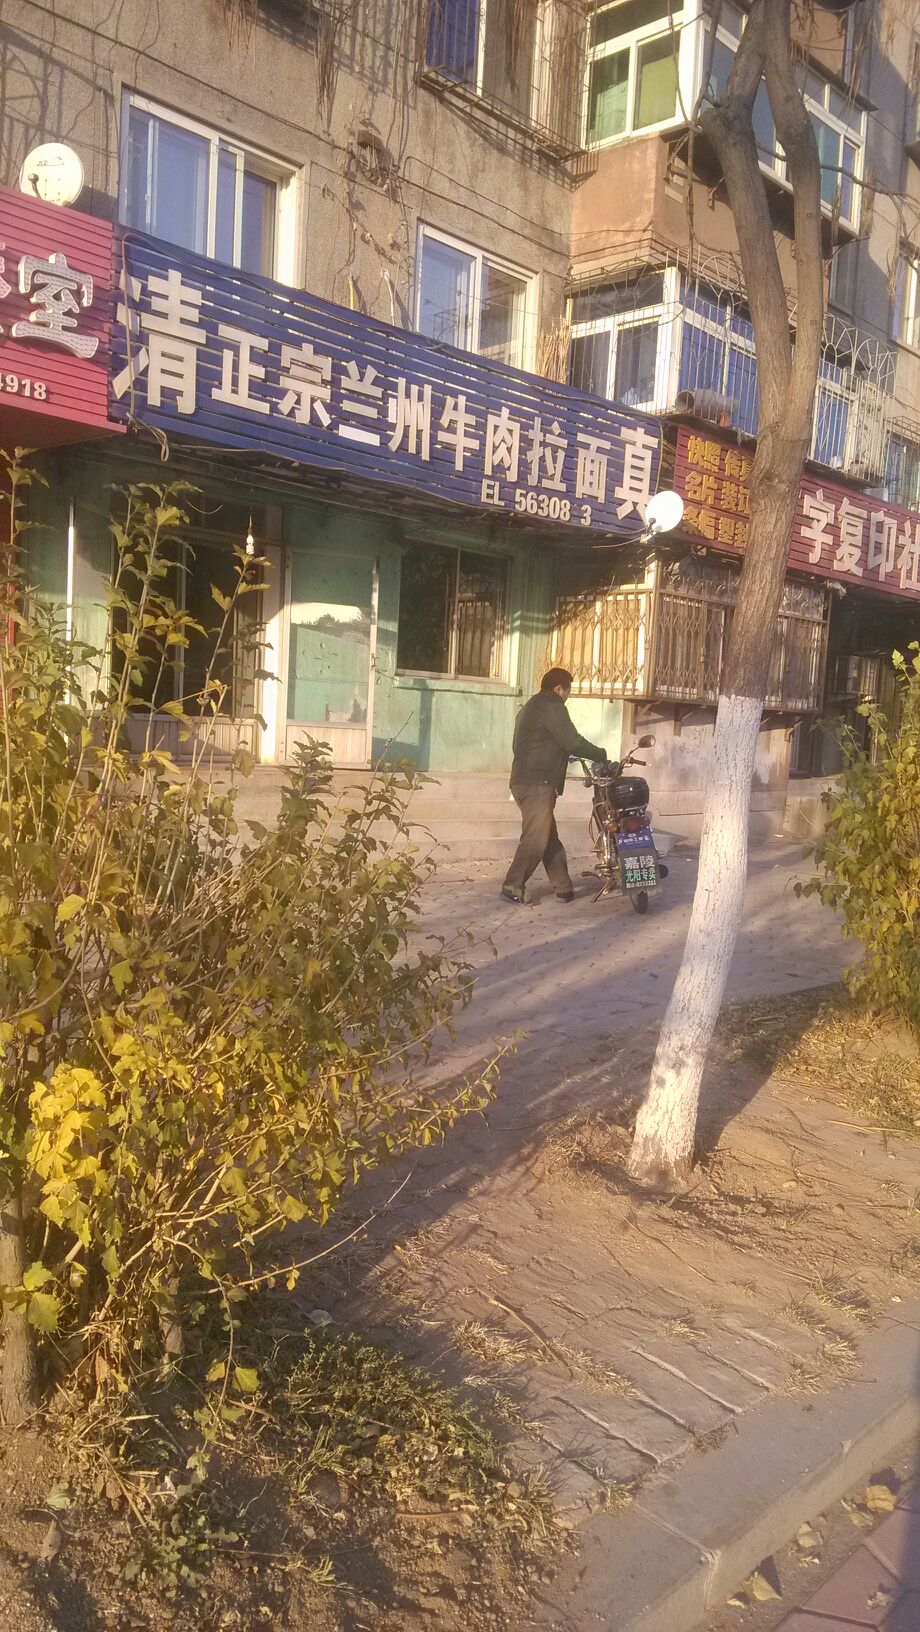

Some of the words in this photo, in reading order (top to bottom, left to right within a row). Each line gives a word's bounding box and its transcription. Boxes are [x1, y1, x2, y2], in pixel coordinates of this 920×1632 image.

[0, 242, 99, 358] 室
[0, 372, 47, 400] 918
[684, 470, 718, 505] 名片
[799, 488, 920, 590] 字复印社
[624, 855, 656, 870] 嘉陵
[625, 867, 656, 883] 光阳专卖
